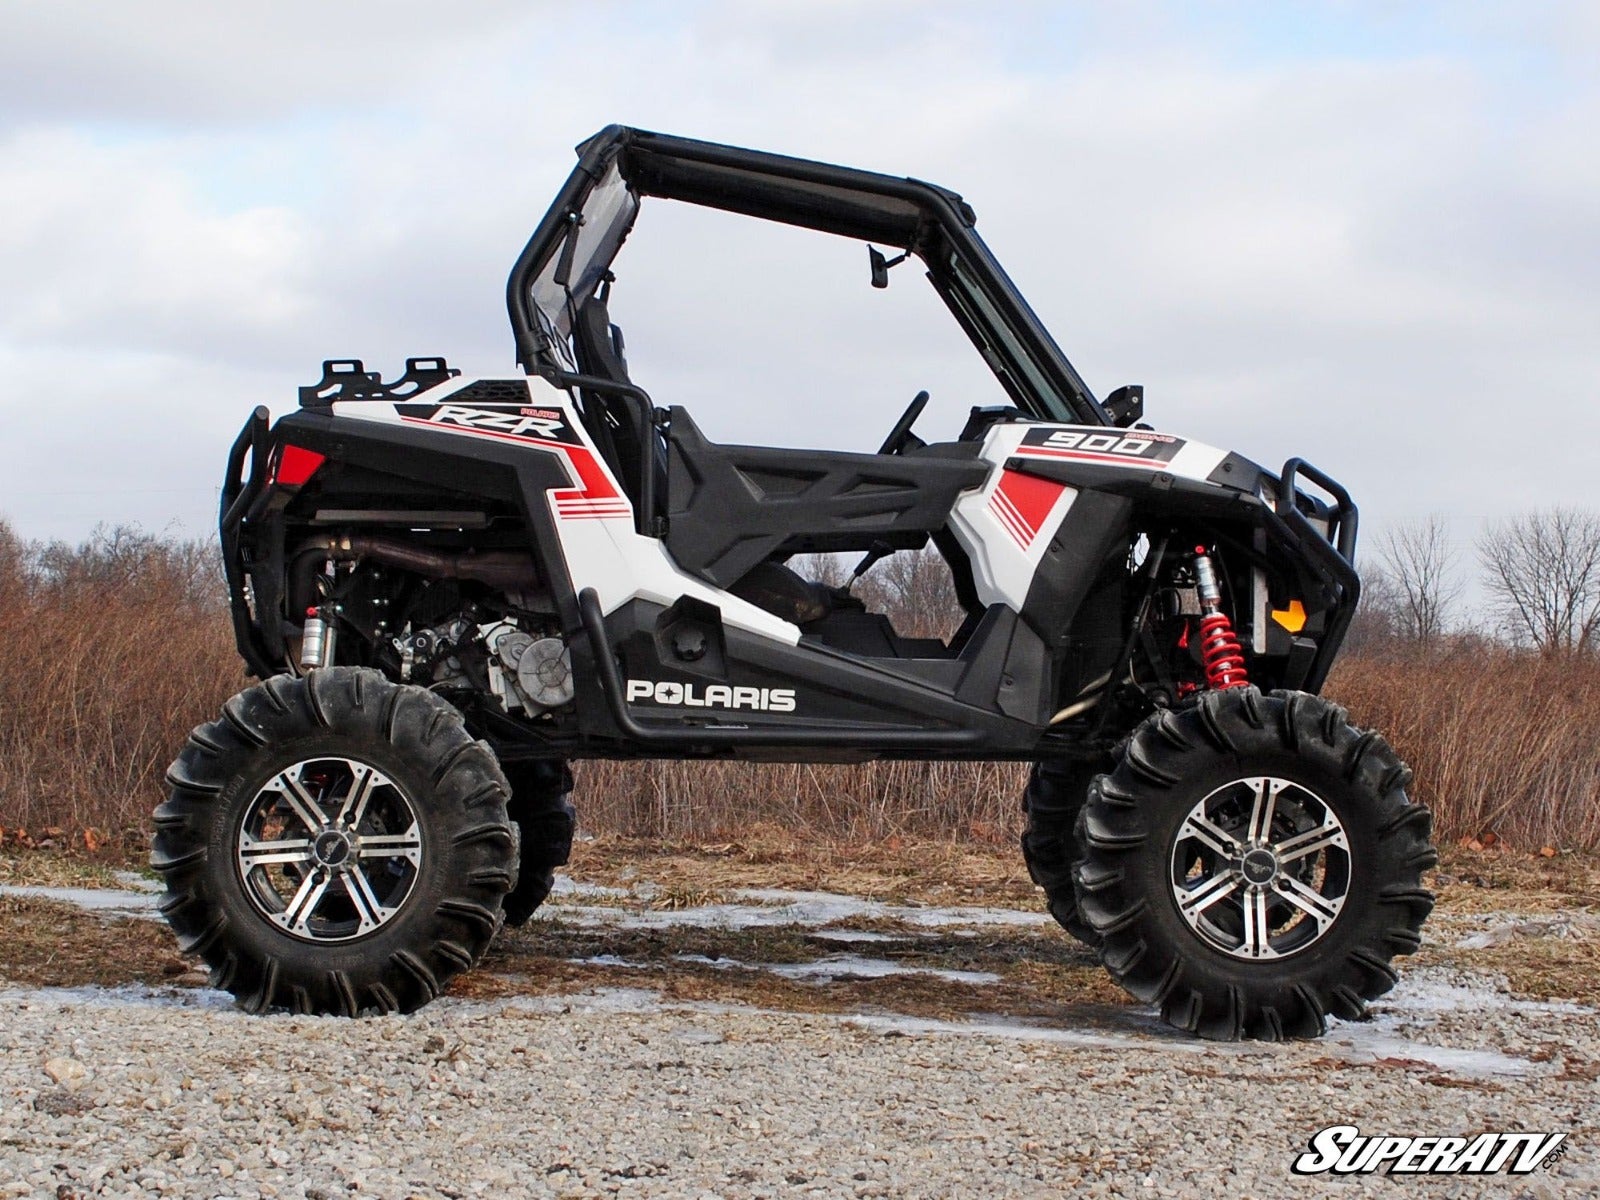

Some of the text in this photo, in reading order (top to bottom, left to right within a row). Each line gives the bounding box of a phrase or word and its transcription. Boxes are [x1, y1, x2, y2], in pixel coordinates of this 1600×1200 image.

[429, 405, 565, 439] RZR
[1042, 431, 1154, 455] 900
[626, 679, 797, 713] POLARIS
